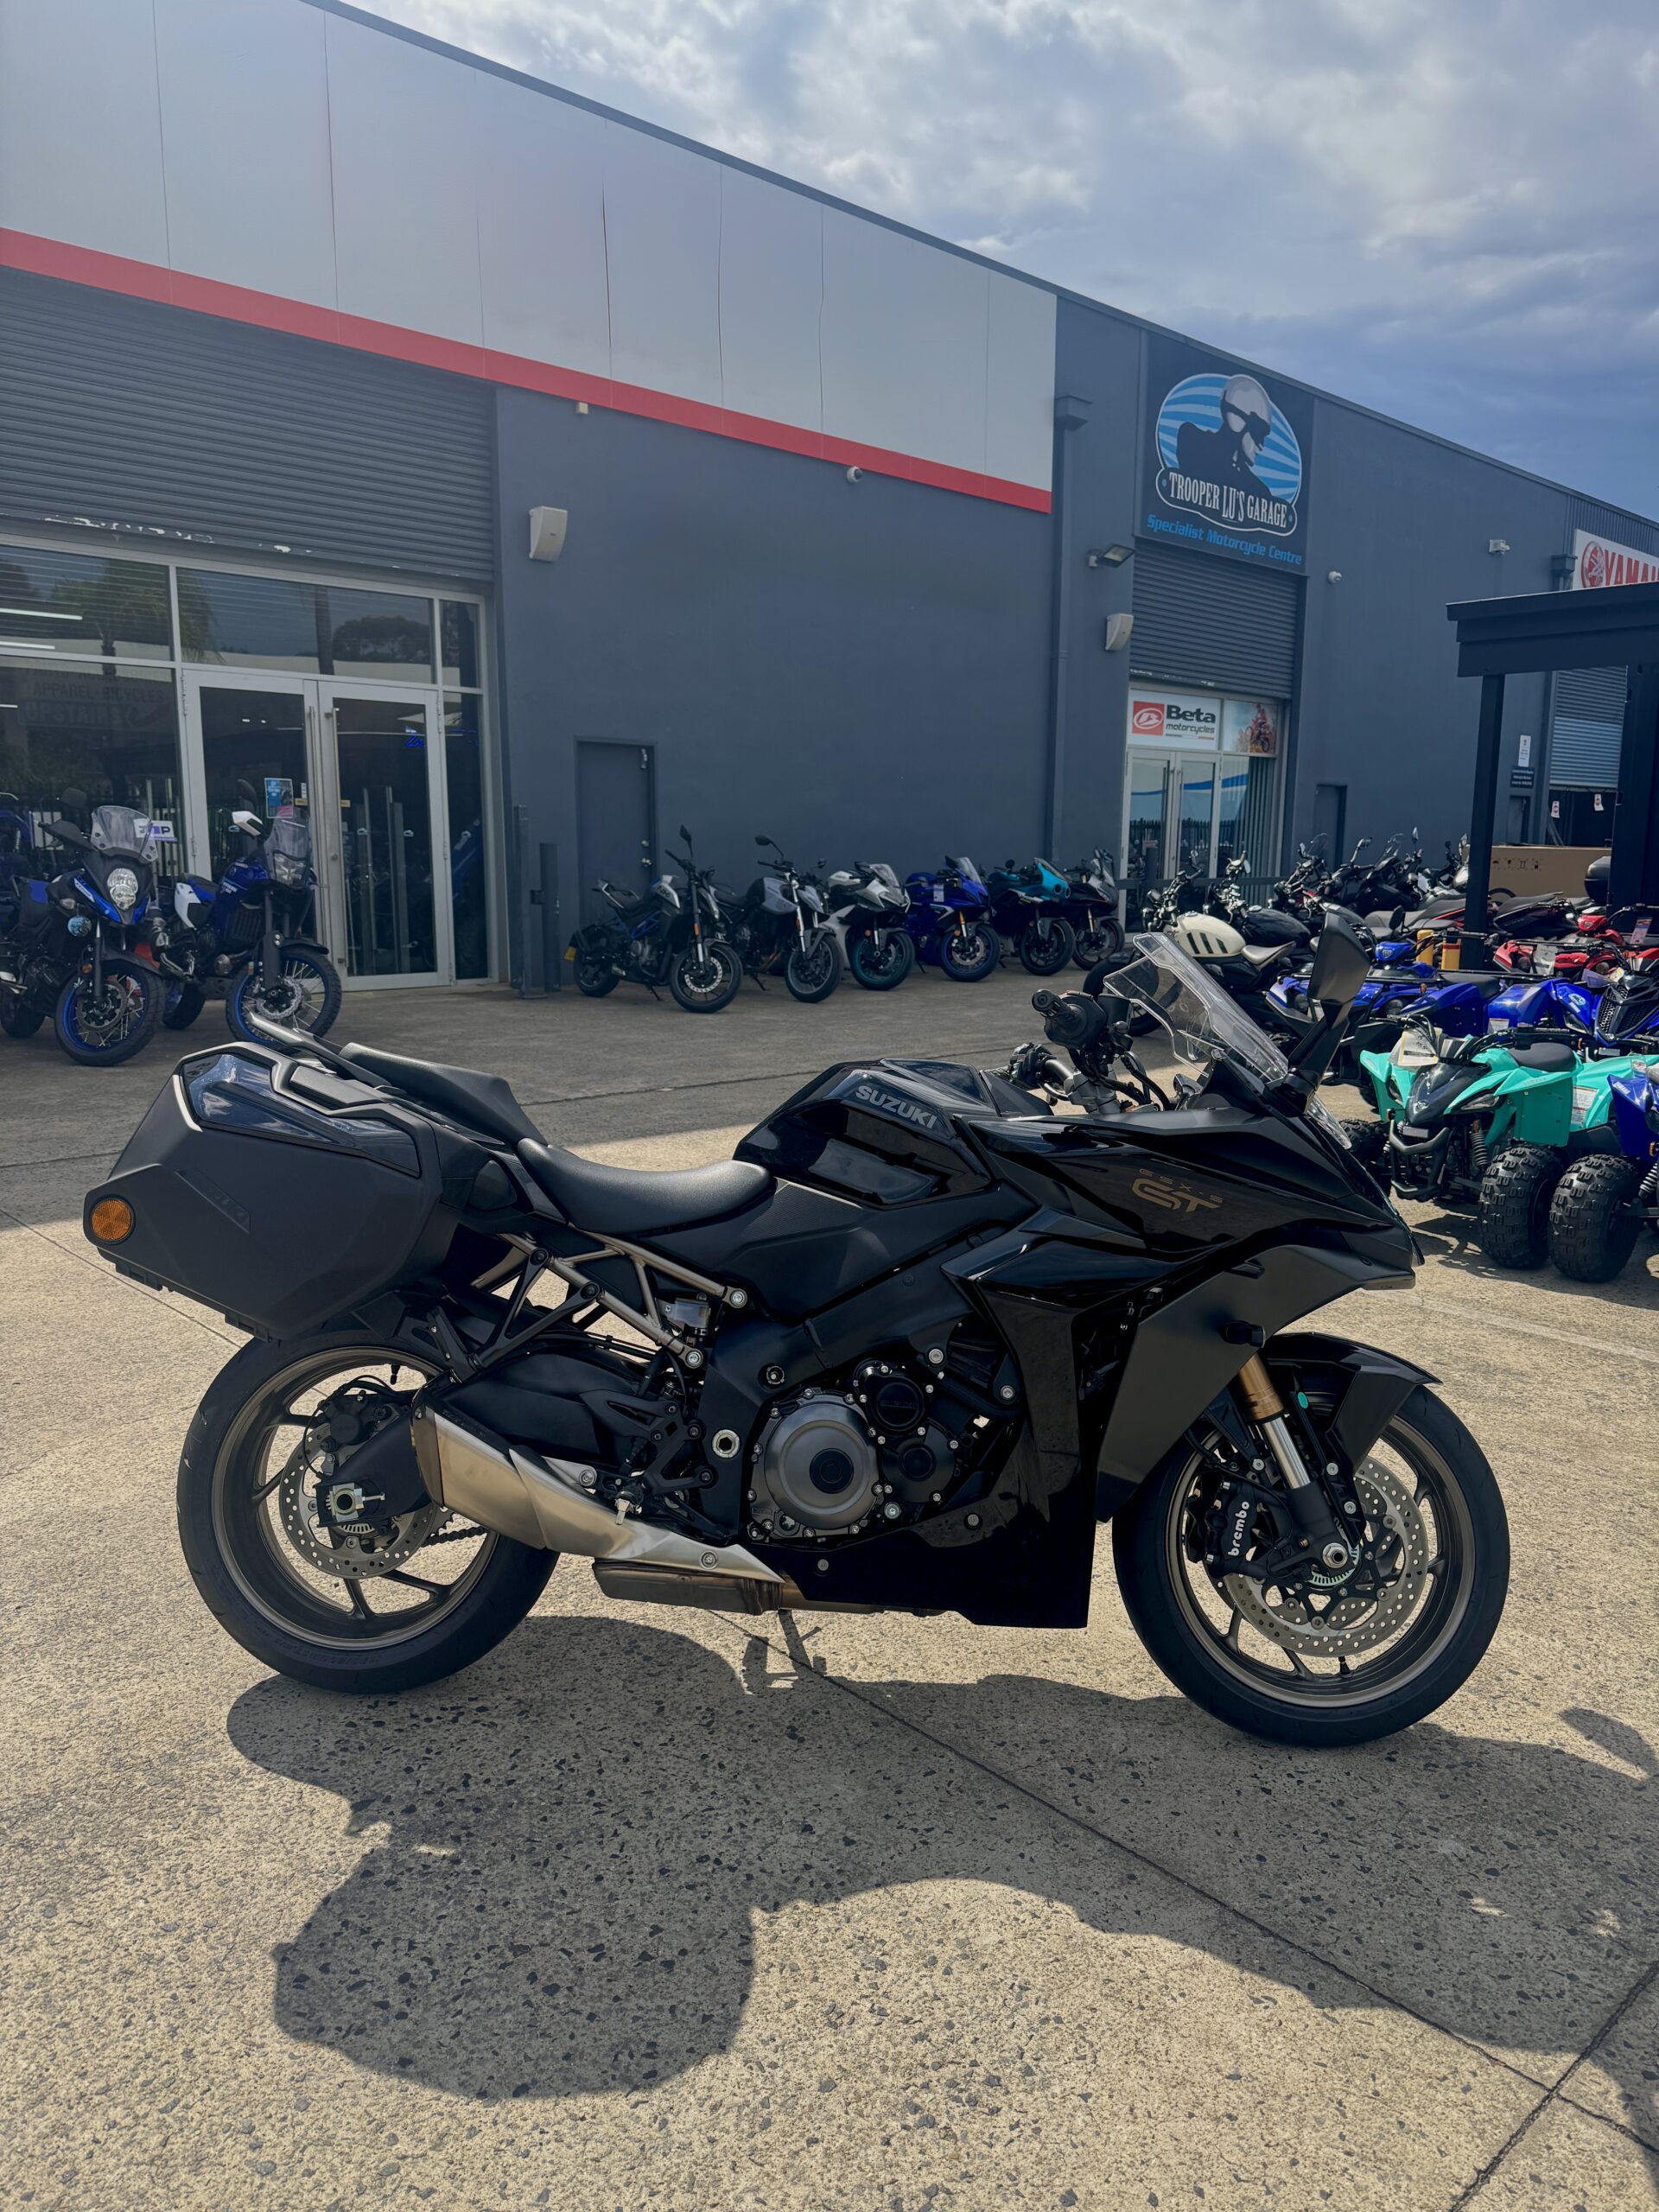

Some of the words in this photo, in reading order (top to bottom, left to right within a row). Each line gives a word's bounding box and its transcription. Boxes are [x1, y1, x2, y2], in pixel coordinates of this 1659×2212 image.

[1169, 472, 1220, 510] TROOPER
[1222, 486, 1245, 523] LU'S
[1247, 494, 1287, 528] GARAGE
[1147, 514, 1204, 541] Specialist
[1207, 529, 1266, 556] Motorcycle
[1268, 544, 1302, 565] Centre
[1165, 722, 1215, 734] motorcycles
[1166, 704, 1216, 723] Beta
[855, 1085, 938, 1129] SUZUKI
